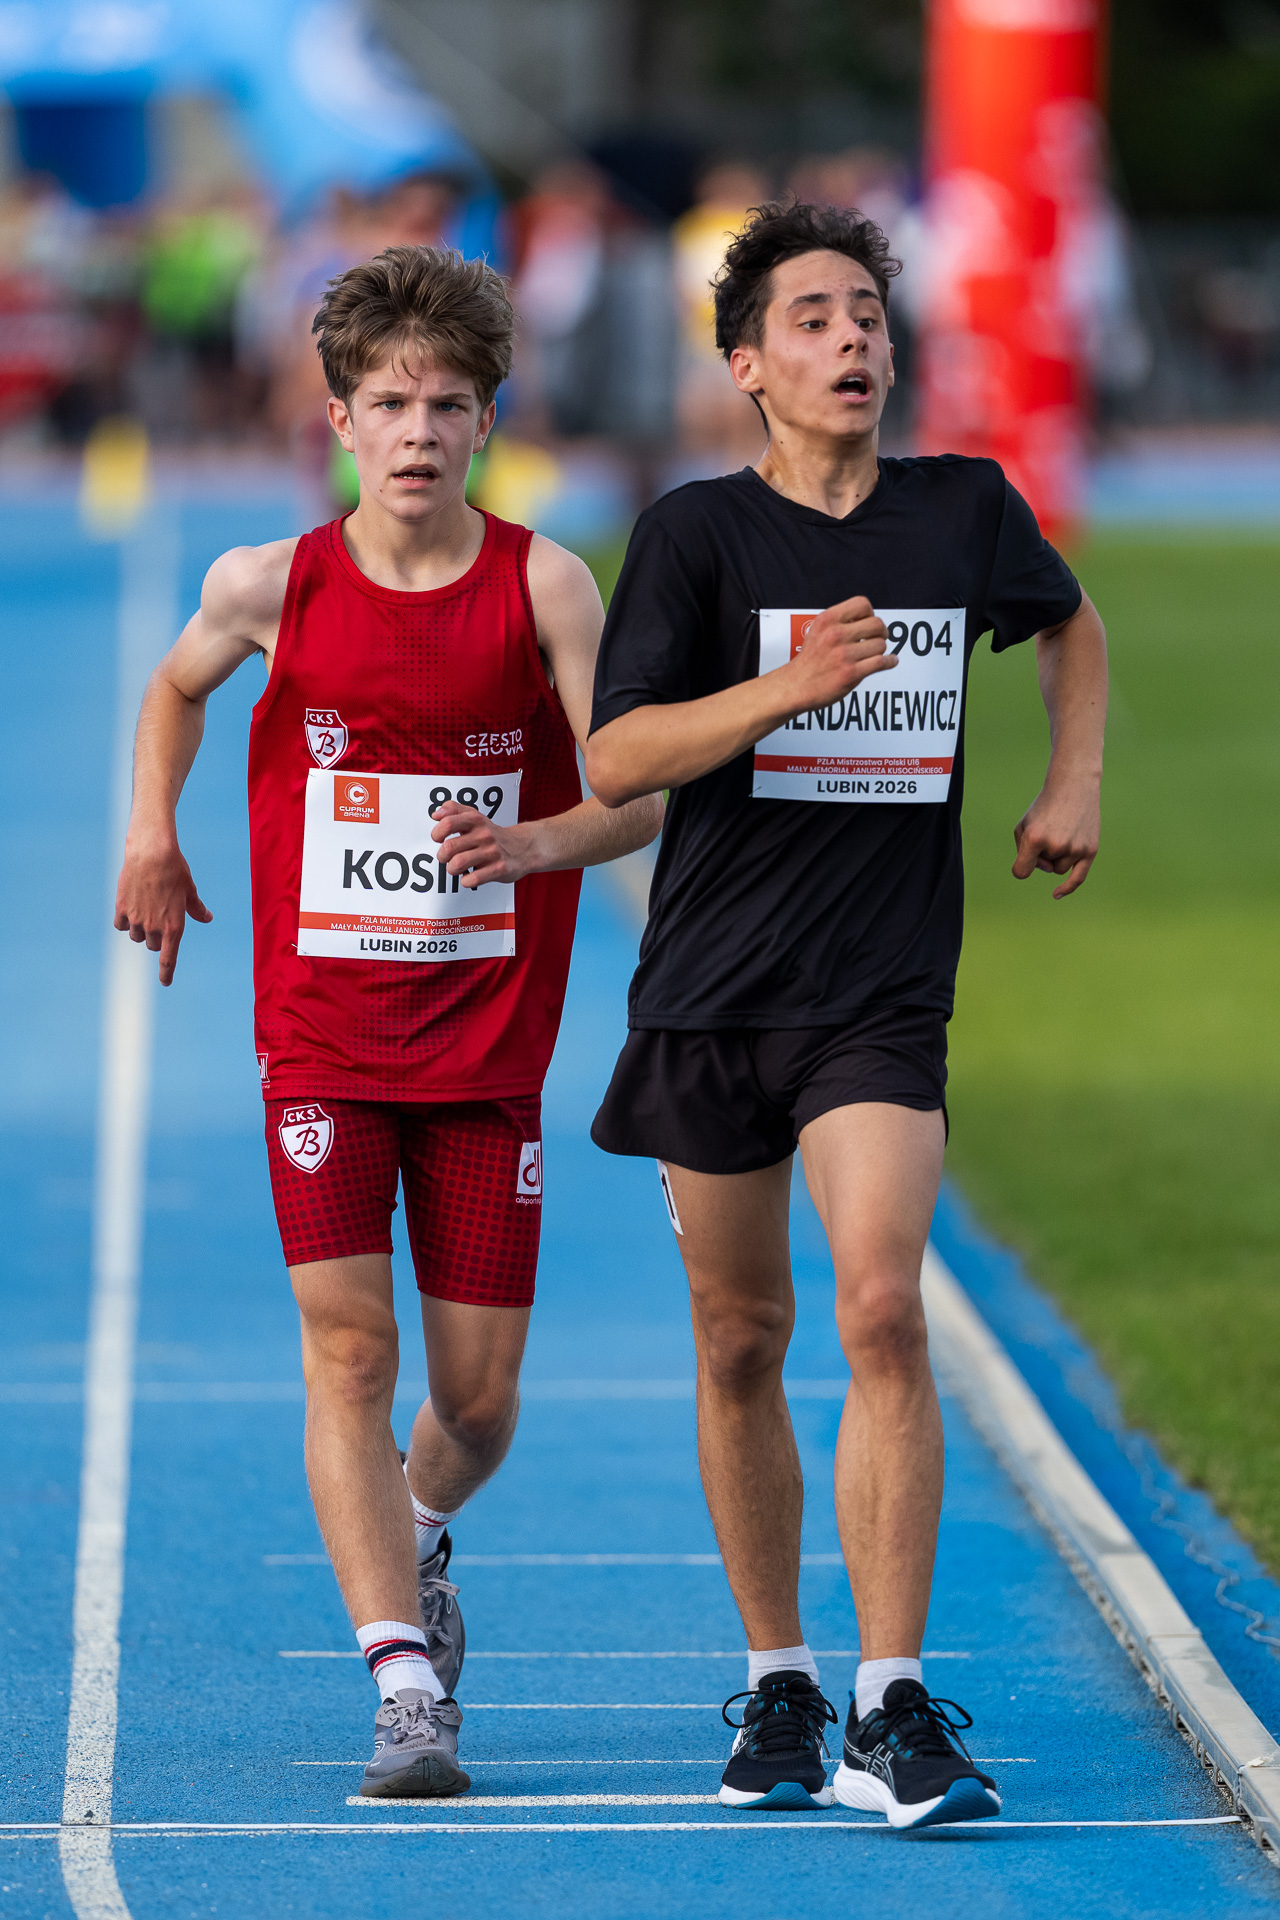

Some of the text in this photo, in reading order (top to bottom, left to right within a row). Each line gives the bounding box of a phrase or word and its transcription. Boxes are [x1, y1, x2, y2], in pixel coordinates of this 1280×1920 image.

[887, 620, 953, 657] 904
[309, 713, 333, 725] CKS
[316, 730, 337, 757] B
[836, 758, 883, 766] Mistrzostwa
[884, 758, 906, 766] Polski
[907, 758, 920, 766] U16
[786, 765, 808, 773] MAŁY
[809, 766, 849, 774] MEMORIAŁ
[887, 766, 944, 775] KUSOCIŃSKIEGO
[817, 780, 918, 794] LUBIN 2026
[339, 805, 375, 814] CUPRUM
[360, 916, 461, 927] PZLA Mistrzostwa Polski U16
[330, 923, 485, 935] MAŁY MEMORIAŁ JANUSZA KUSOCIŃSKIEGO
[360, 938, 458, 953] LUBIN 2026
[287, 1109, 317, 1123] CKS
[293, 1125, 321, 1156] B
